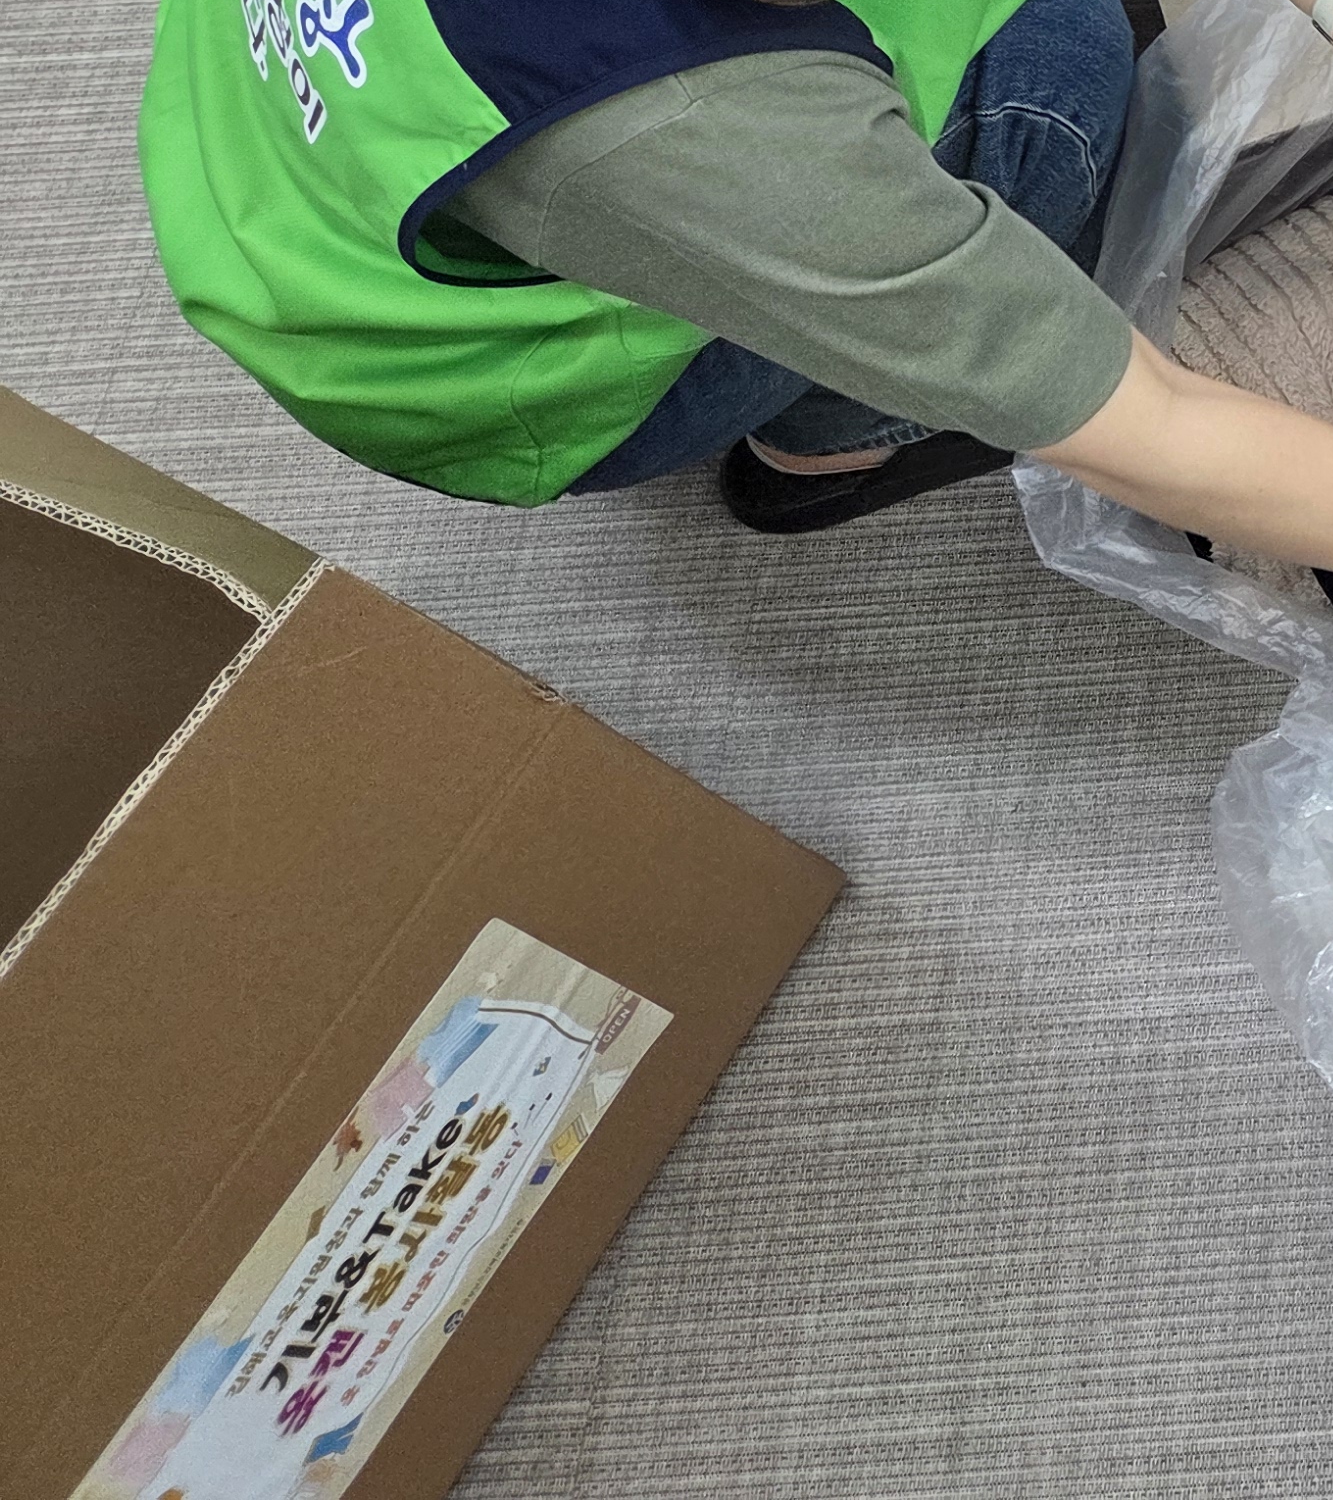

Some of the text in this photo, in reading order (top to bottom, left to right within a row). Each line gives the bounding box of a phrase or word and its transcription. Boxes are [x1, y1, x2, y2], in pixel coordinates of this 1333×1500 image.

[603, 1009, 630, 1043] OPEN
[260, 1117, 463, 1393] 기부&Take
[277, 1329, 364, 1436] 옷캔
[358, 1102, 508, 1315] 봉사활동
